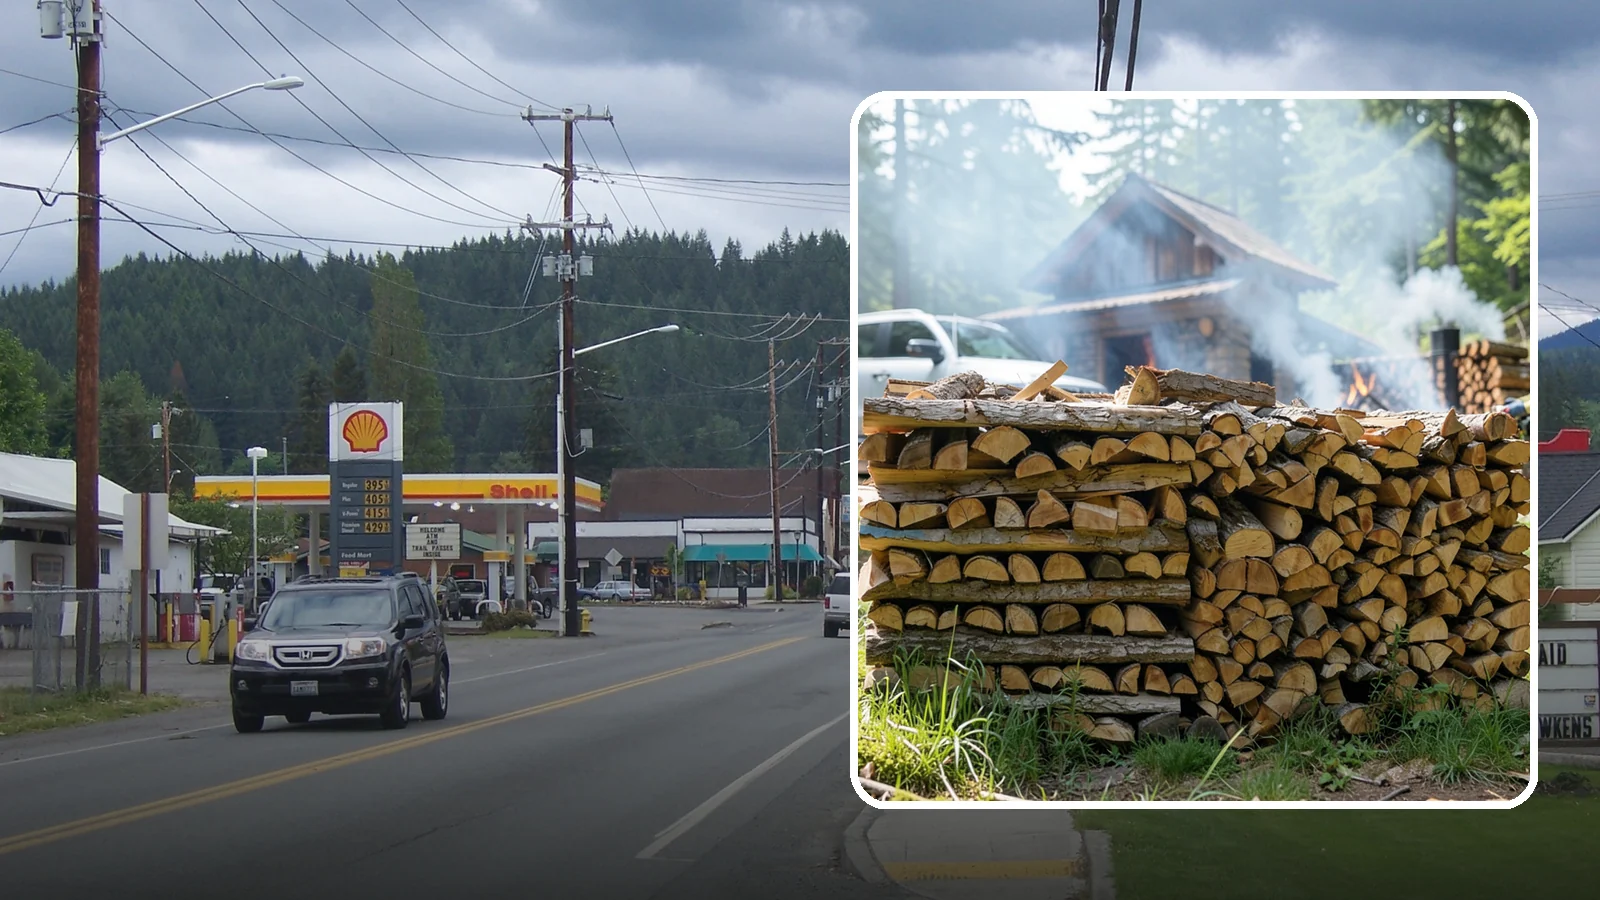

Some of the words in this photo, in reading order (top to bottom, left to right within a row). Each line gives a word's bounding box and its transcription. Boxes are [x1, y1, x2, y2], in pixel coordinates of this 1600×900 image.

[366, 480, 383, 490] 395
[490, 484, 547, 499] Shell
[366, 494, 383, 504] 405
[366, 508, 383, 518] 415
[366, 522, 383, 532] 429
[1539, 643, 1567, 665] AID
